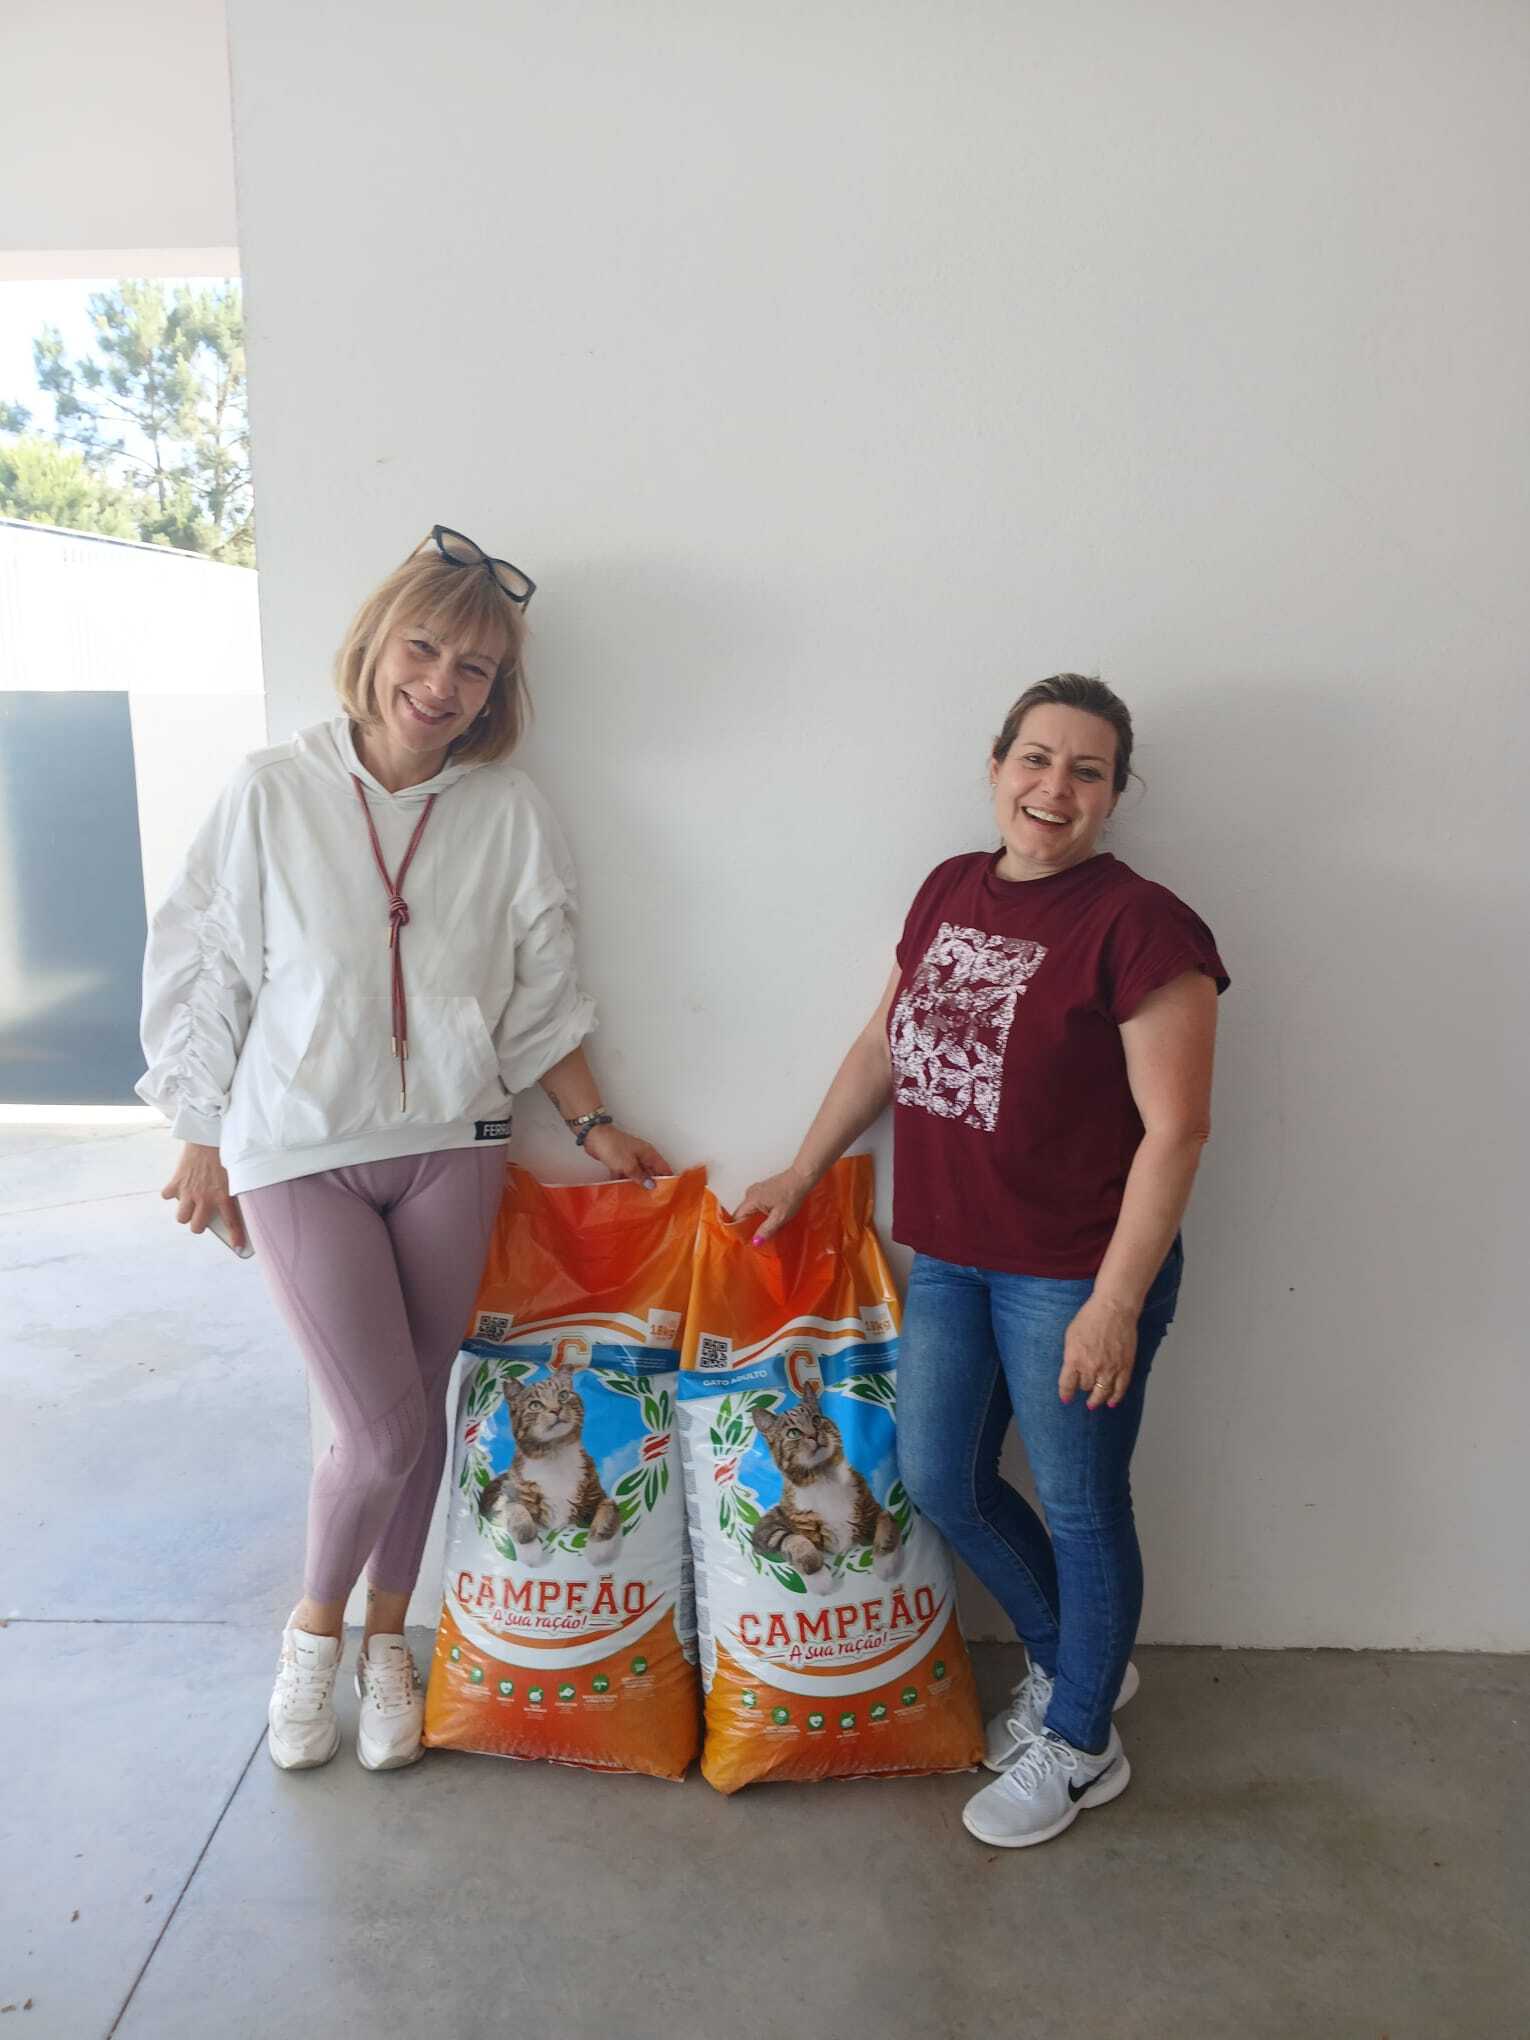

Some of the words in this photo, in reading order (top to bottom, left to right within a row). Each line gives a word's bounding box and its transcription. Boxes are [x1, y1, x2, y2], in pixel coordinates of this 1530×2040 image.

[456, 1571, 646, 1615] CAMPEÃO
[505, 1612, 532, 1626] sua
[535, 1615, 588, 1630] ração!
[739, 1584, 936, 1647] CAMPEÃO
[789, 1644, 802, 1661] A
[805, 1646, 833, 1660] sua
[838, 1631, 888, 1655] ração!
